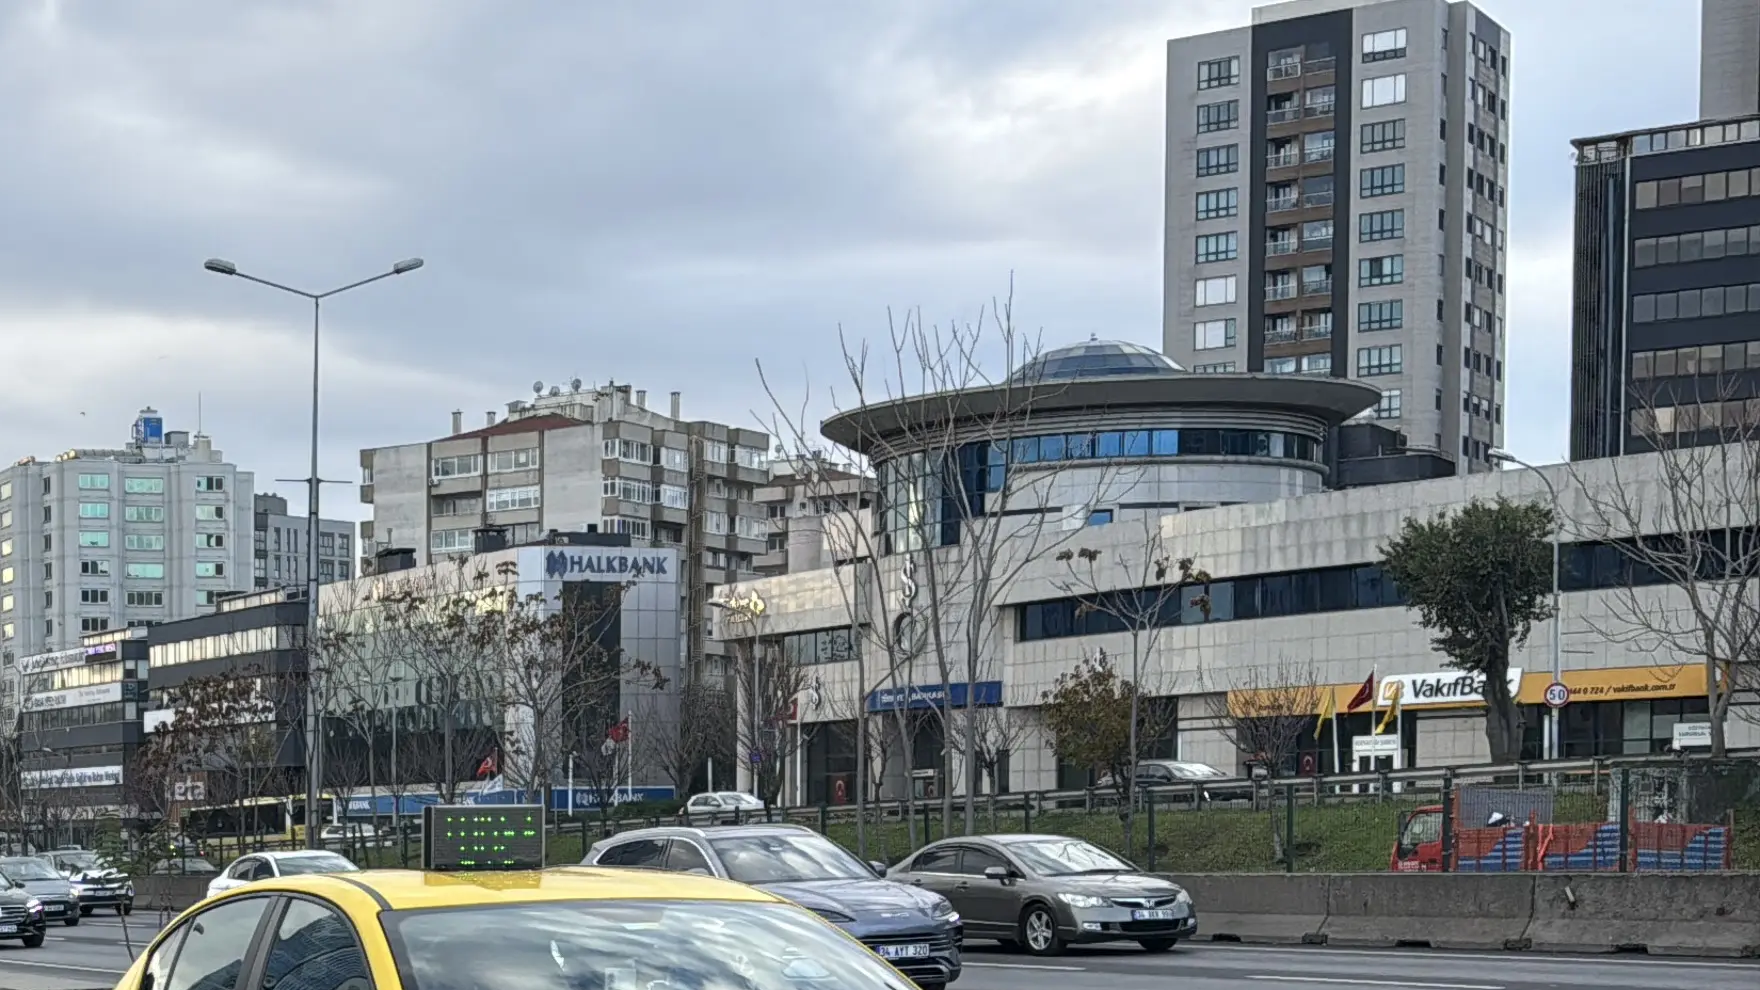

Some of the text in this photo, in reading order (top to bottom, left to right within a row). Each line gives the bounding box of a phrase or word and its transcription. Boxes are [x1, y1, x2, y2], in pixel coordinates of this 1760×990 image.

[570, 555, 668, 574] HALKBANK
[1412, 676, 1513, 698] VakıfBa
[1549, 690, 1566, 700] 50
[895, 946, 909, 956] AYT
[912, 945, 927, 956] 320
